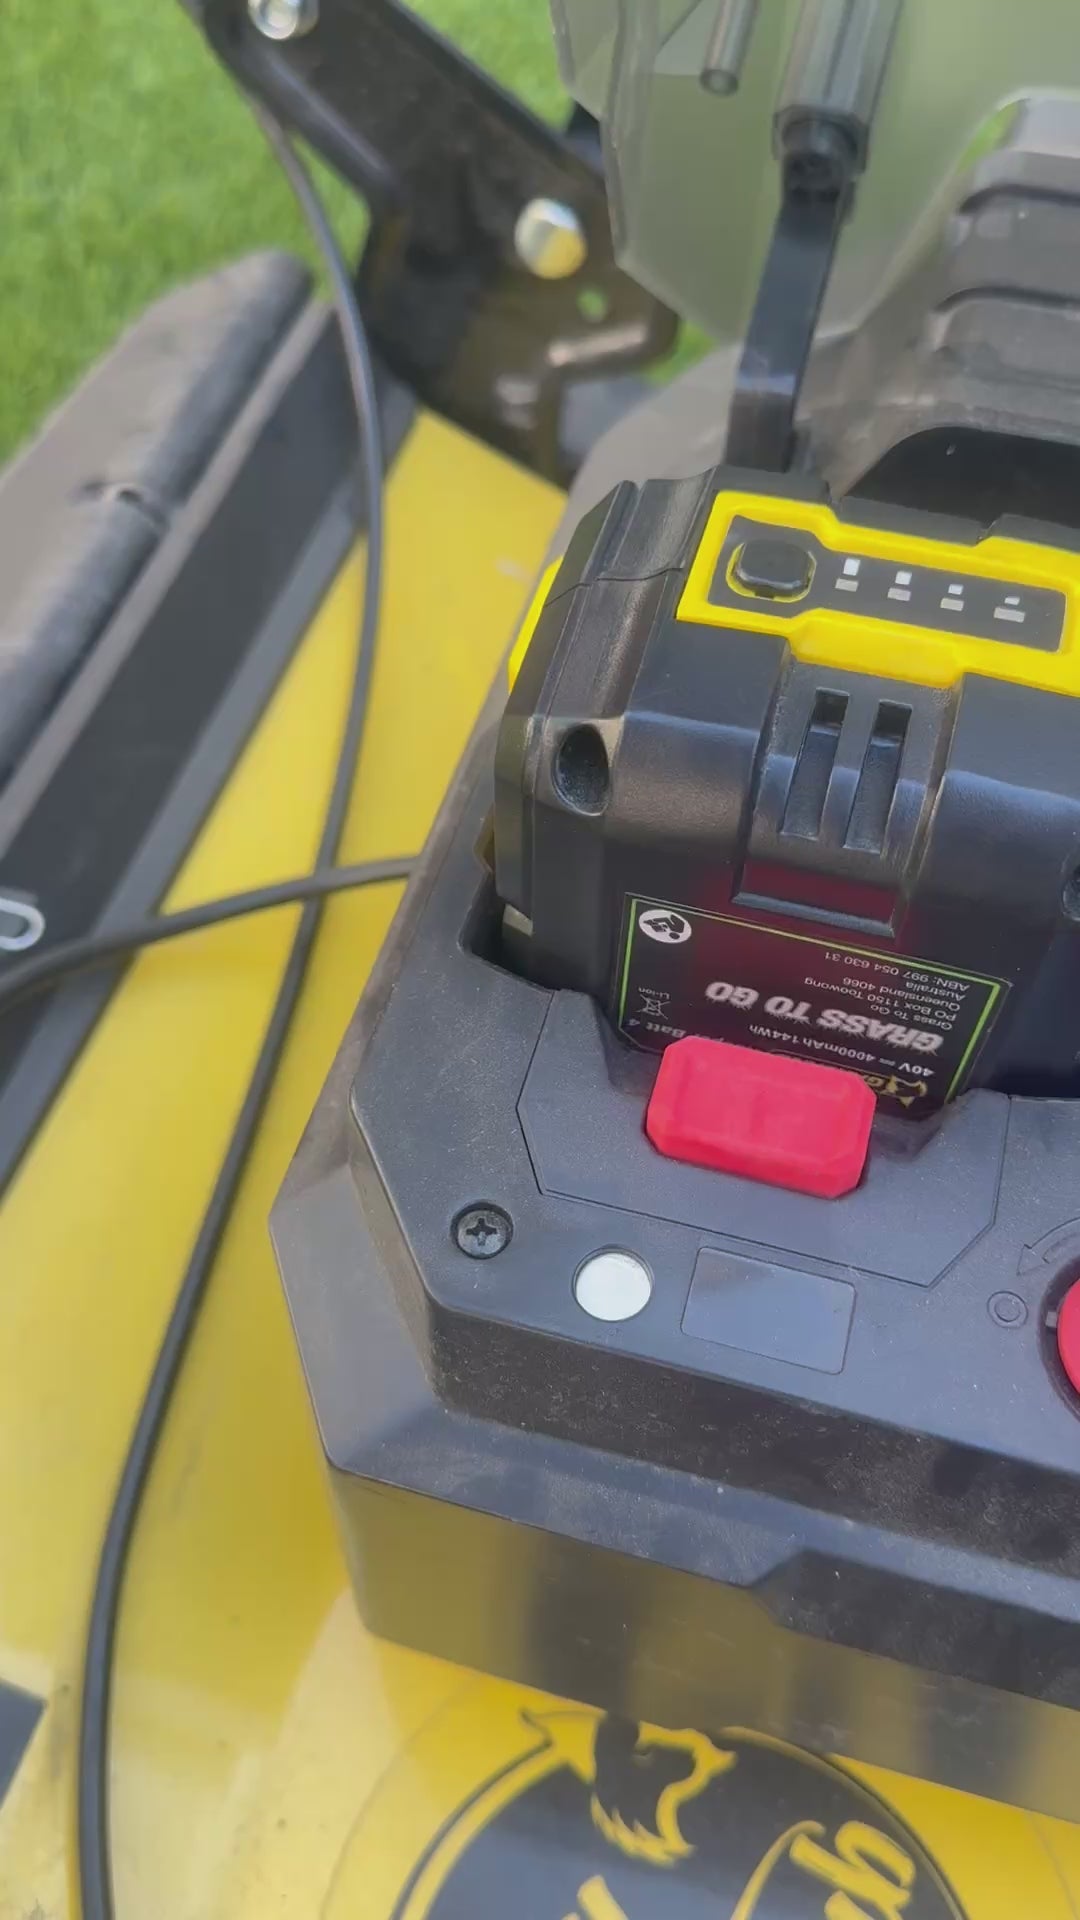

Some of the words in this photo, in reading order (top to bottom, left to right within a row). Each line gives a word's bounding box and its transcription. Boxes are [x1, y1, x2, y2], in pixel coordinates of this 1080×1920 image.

[825, 952, 840, 961] 31
[844, 956, 870, 968] 630
[874, 963, 899, 975] 054
[904, 971, 928, 982] 997
[932, 976, 970, 991] ABN:
[804, 977, 862, 999] Toowong
[843, 977, 875, 991] 4066
[638, 987, 670, 1000] Li-ion
[704, 981, 759, 1009] GO
[879, 985, 961, 1011] Queensland
[906, 982, 965, 1001] Australia
[867, 994, 899, 1006] 1150
[764, 995, 810, 1023] TO
[870, 1004, 890, 1015] Go
[894, 1010, 908, 1020] To
[905, 1002, 931, 1014] Box
[914, 1014, 953, 1031] Grass
[935, 1010, 957, 1021] PO
[749, 1024, 798, 1044] 144Wh
[816, 1009, 944, 1054] GRASS
[803, 1037, 876, 1062] 4000mAh
[898, 1062, 934, 1077] 40V
